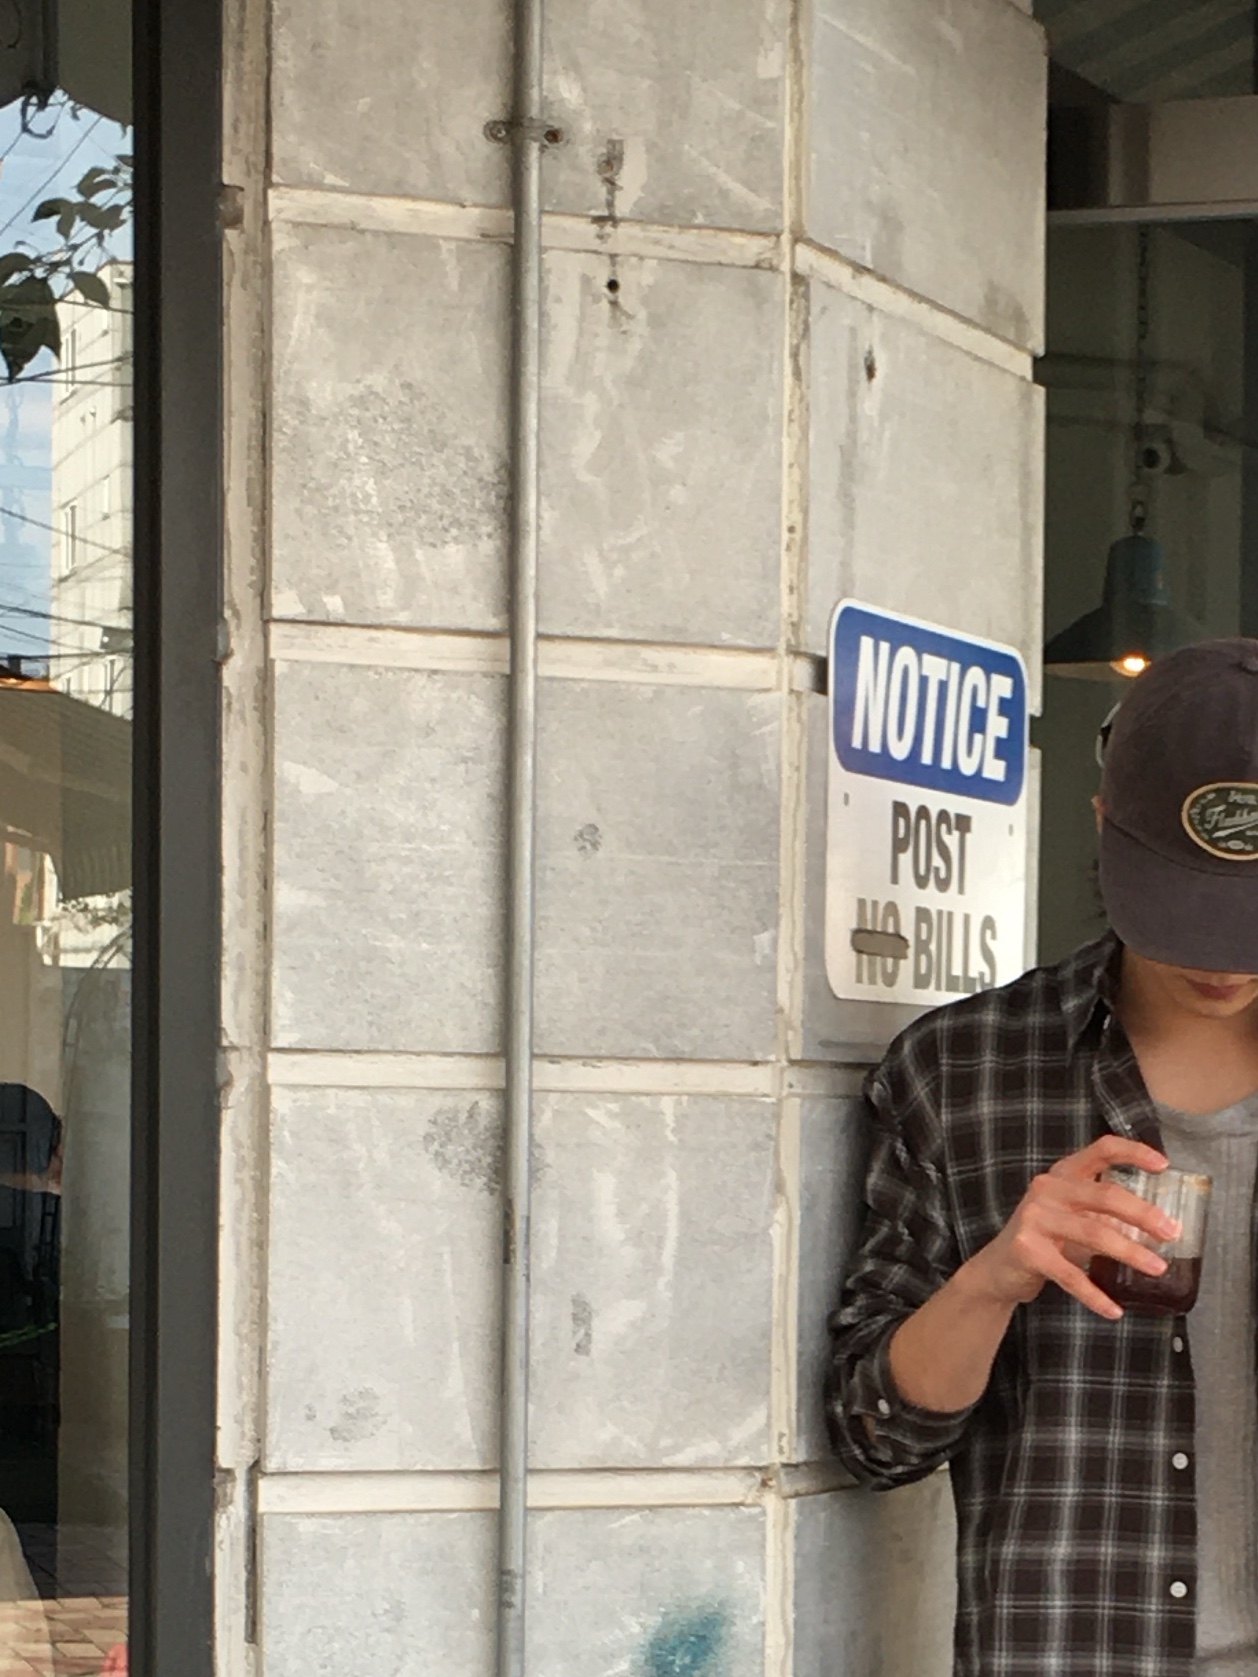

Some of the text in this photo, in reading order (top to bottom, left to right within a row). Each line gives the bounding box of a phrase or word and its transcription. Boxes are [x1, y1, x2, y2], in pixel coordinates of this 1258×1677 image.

[851, 634, 1014, 783] NOTICE
[889, 800, 972, 895] POST
[912, 905, 998, 991] BILLS
